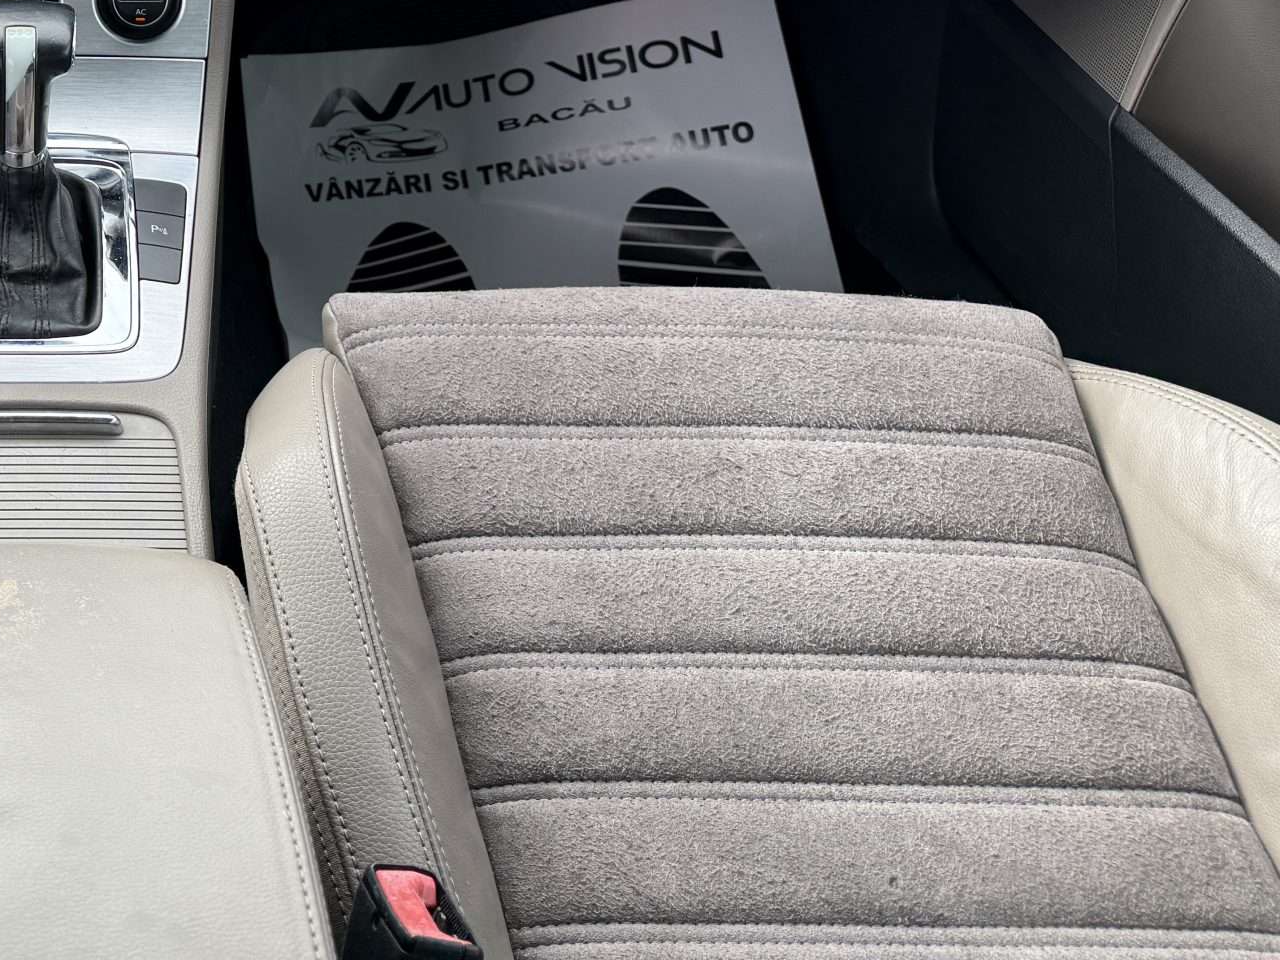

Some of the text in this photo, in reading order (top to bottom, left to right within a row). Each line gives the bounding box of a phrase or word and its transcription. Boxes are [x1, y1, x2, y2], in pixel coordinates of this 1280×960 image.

[135, 8, 147, 16] AC
[406, 30, 724, 114] AUTO VISION
[497, 96, 632, 132] BACĂU
[305, 120, 754, 203] VÂNZĂRI SI TRANSPORT AUTO
